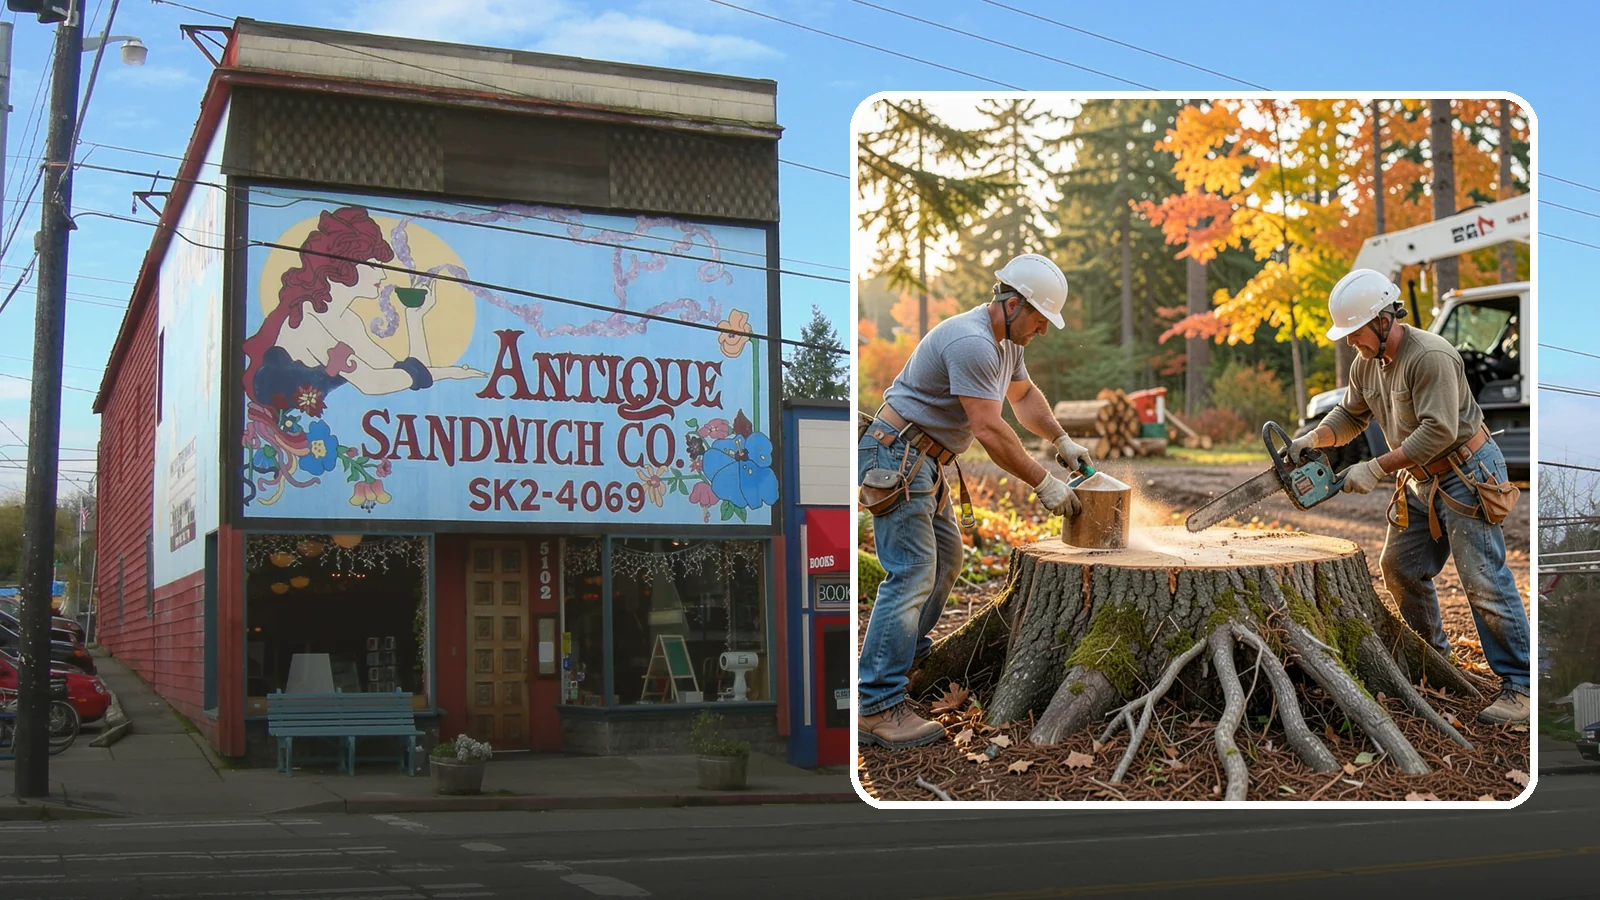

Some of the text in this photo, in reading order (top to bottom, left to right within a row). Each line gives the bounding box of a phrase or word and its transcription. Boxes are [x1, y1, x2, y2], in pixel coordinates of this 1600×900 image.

[476, 329, 724, 420] ANTIQUE
[361, 409, 685, 468] SANDWICH CO.
[468, 477, 646, 512] SK2-4069
[540, 541, 551, 600] 5102
[809, 555, 835, 569] BOOKS
